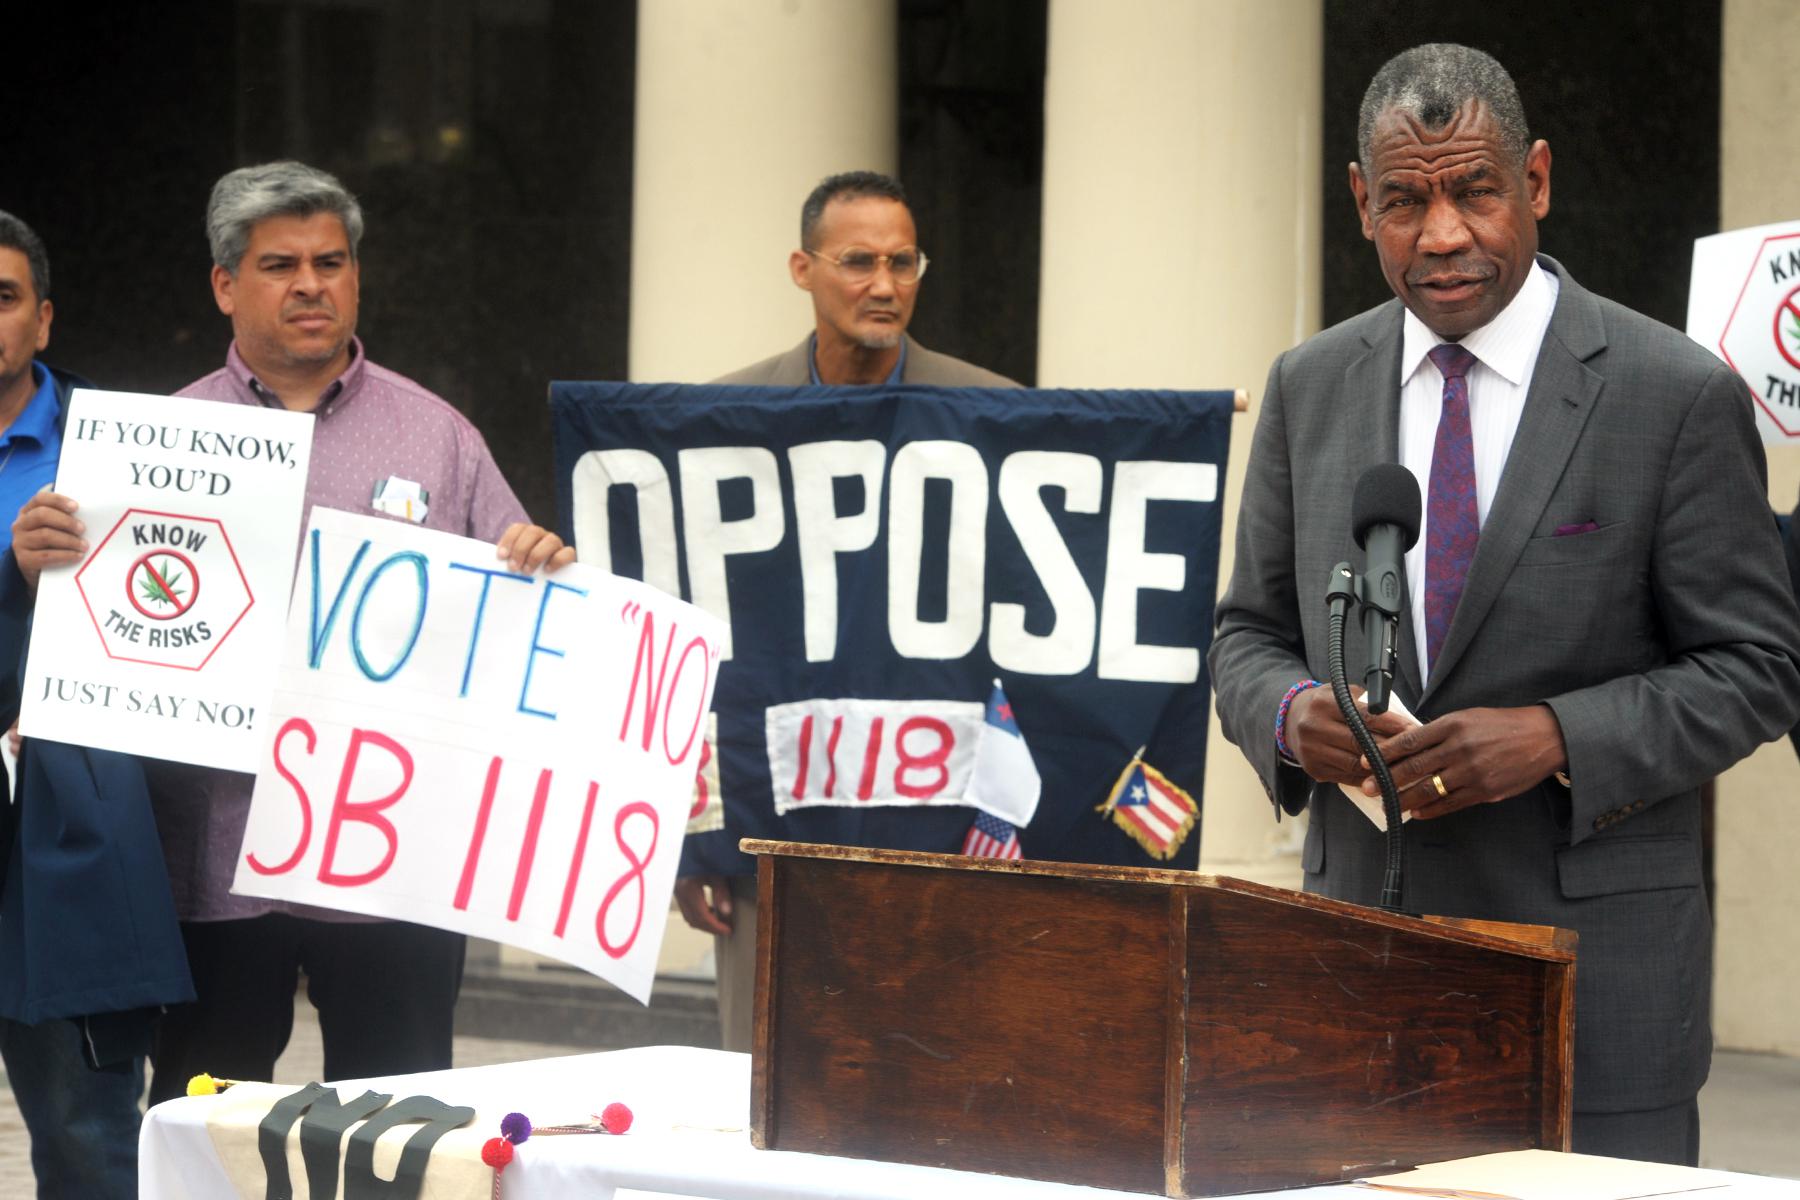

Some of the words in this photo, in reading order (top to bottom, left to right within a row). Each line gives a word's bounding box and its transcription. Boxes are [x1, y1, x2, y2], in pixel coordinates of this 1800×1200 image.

[1766, 374, 1800, 409] TH
[76, 418, 106, 441] IF
[115, 422, 182, 449] YOU
[189, 431, 297, 469] KNOW,
[130, 462, 231, 496] YOU'D
[132, 524, 208, 553] KNOW
[572, 440, 1217, 683] OPPOSE
[104, 609, 144, 643] THE
[148, 621, 212, 648] RISKS
[308, 528, 589, 721] VOTE
[42, 677, 118, 707] JUST
[127, 690, 187, 719] SAY
[196, 701, 256, 730] NO!
[791, 716, 956, 799] 1118
[245, 716, 414, 887] SB
[453, 756, 660, 959] 1118
